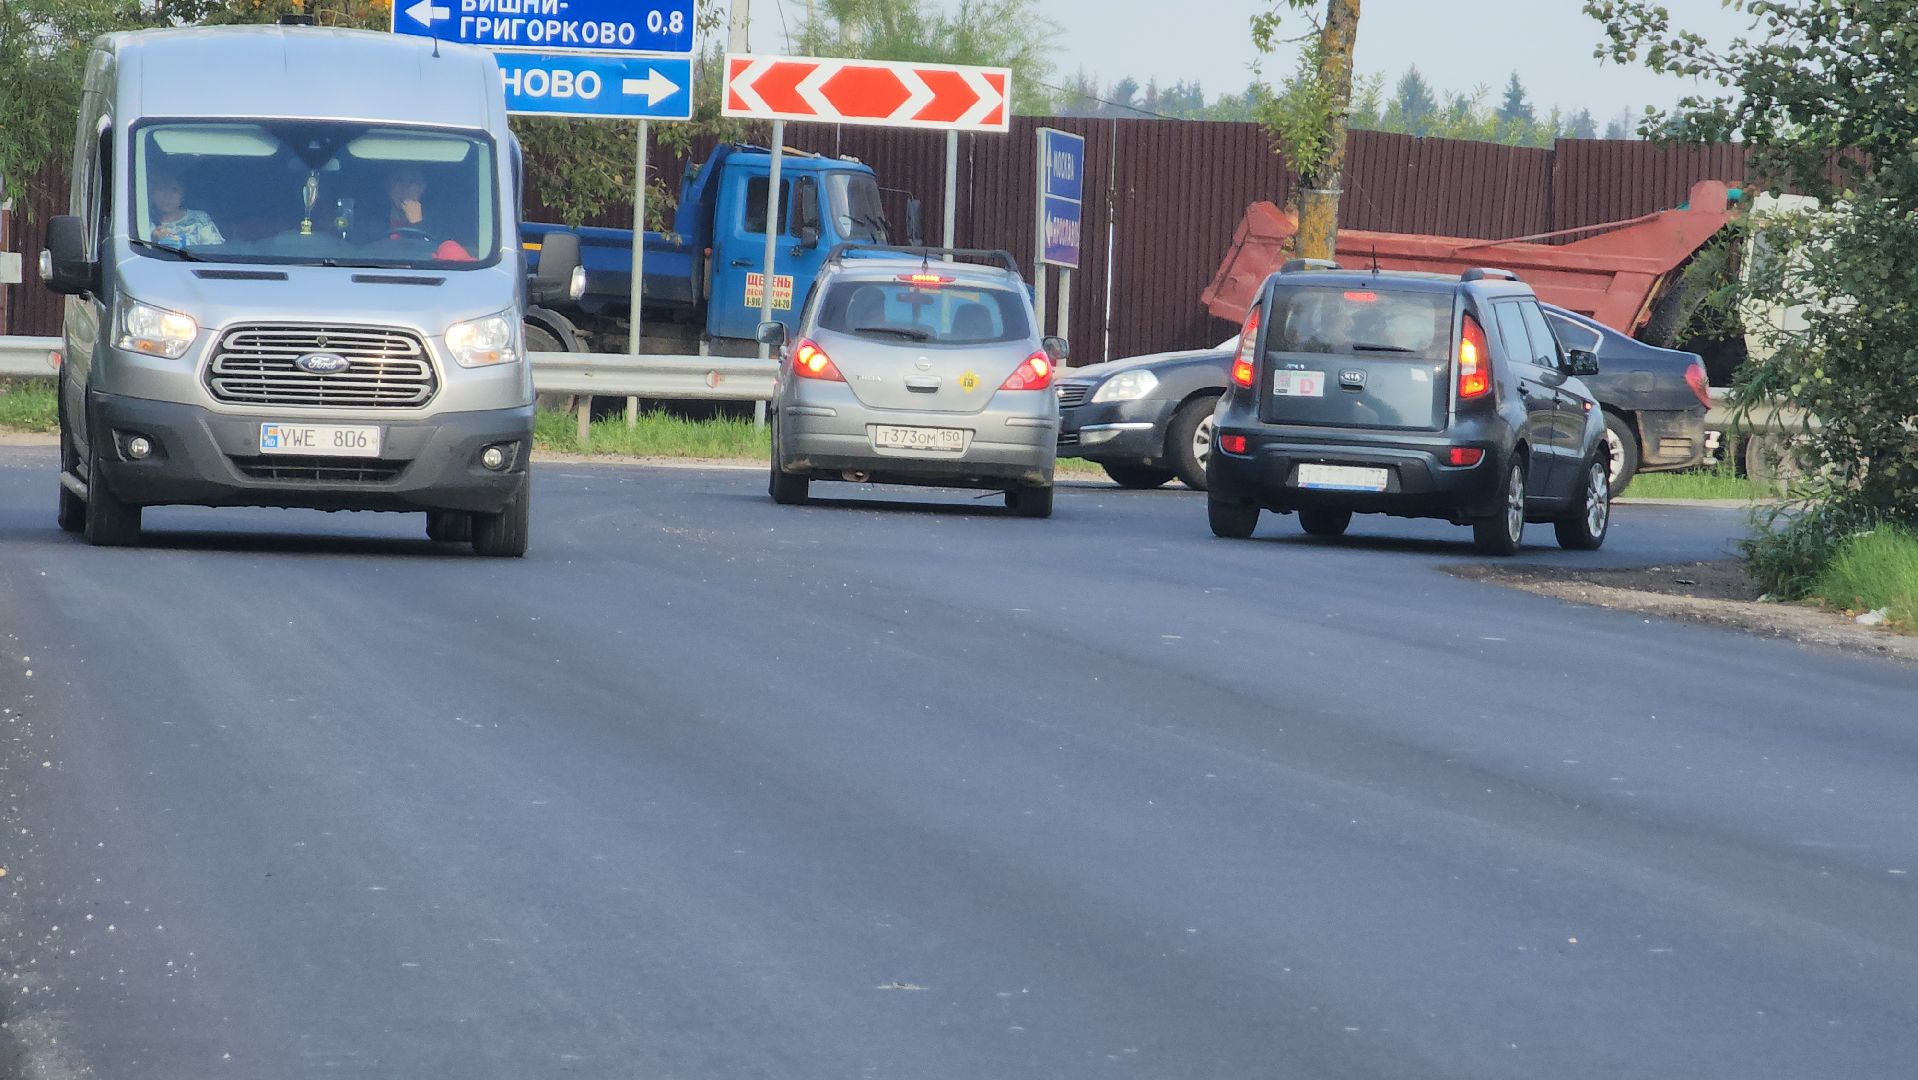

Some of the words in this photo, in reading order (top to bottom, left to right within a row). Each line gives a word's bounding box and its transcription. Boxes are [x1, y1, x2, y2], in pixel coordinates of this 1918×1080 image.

[460, 16, 635, 45] ГРИГОРКОВО
[646, 9, 683, 36] 0,8
[308, 356, 338, 370] Ford
[1344, 372, 1361, 382] KIA
[281, 428, 316, 447] YWE
[333, 430, 367, 448] 806
[940, 431, 960, 442] 150
